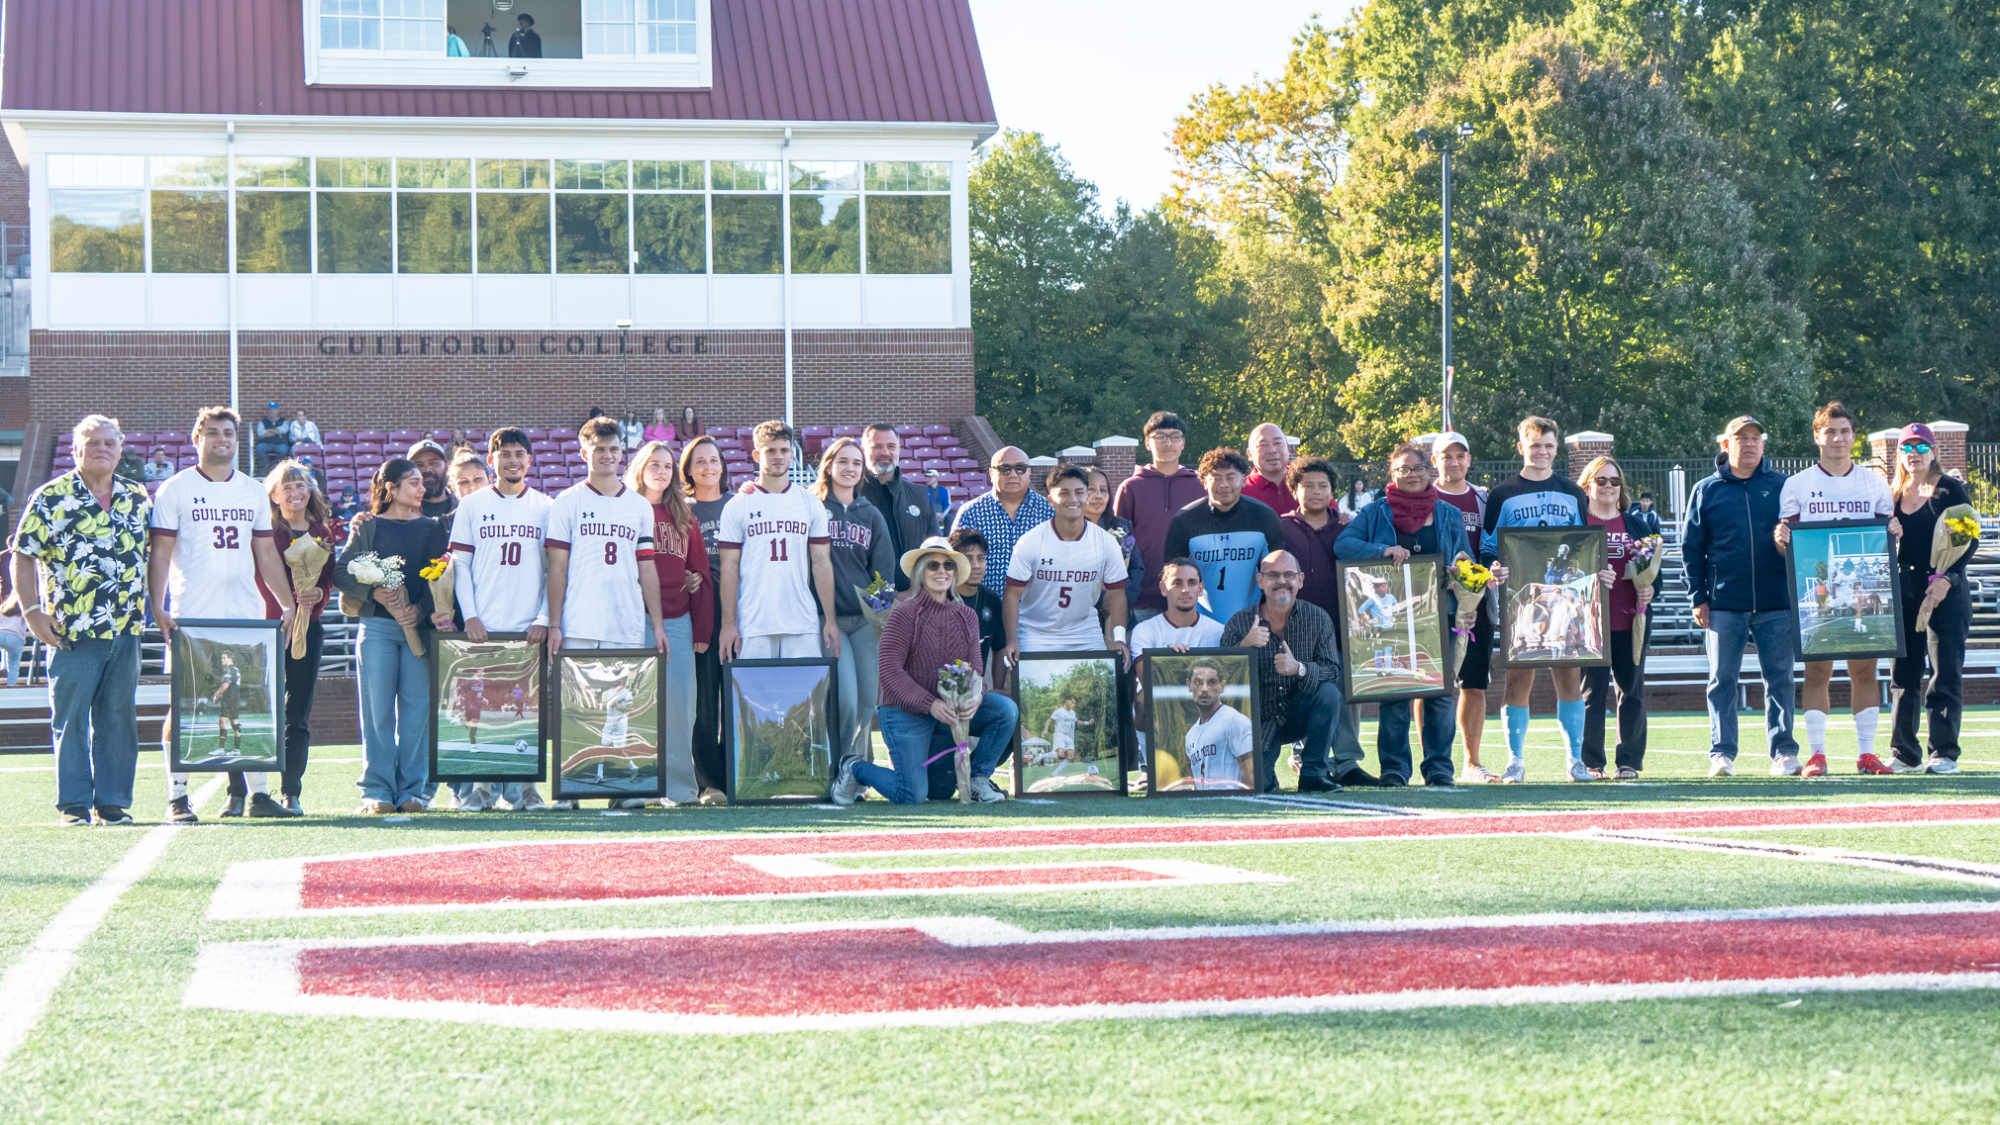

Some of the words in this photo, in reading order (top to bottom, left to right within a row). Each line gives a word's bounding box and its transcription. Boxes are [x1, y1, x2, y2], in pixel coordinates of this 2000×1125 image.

[319, 336, 515, 355] GUILFORD
[539, 336, 708, 354] COLLEGE
[192, 508, 254, 522] GUILFORD
[1808, 501, 1870, 514] GUILFORD
[213, 525, 240, 549] 32
[479, 524, 542, 540] GUILFORD
[747, 520, 808, 537] GUILFORD
[500, 541, 522, 567] 10
[604, 541, 618, 566] 8
[770, 537, 788, 562] 11
[1194, 547, 1256, 563] GUILFORD
[1036, 569, 1098, 583] GUILFORD
[1217, 566, 1226, 591] 1
[1058, 586, 1073, 609] 5
